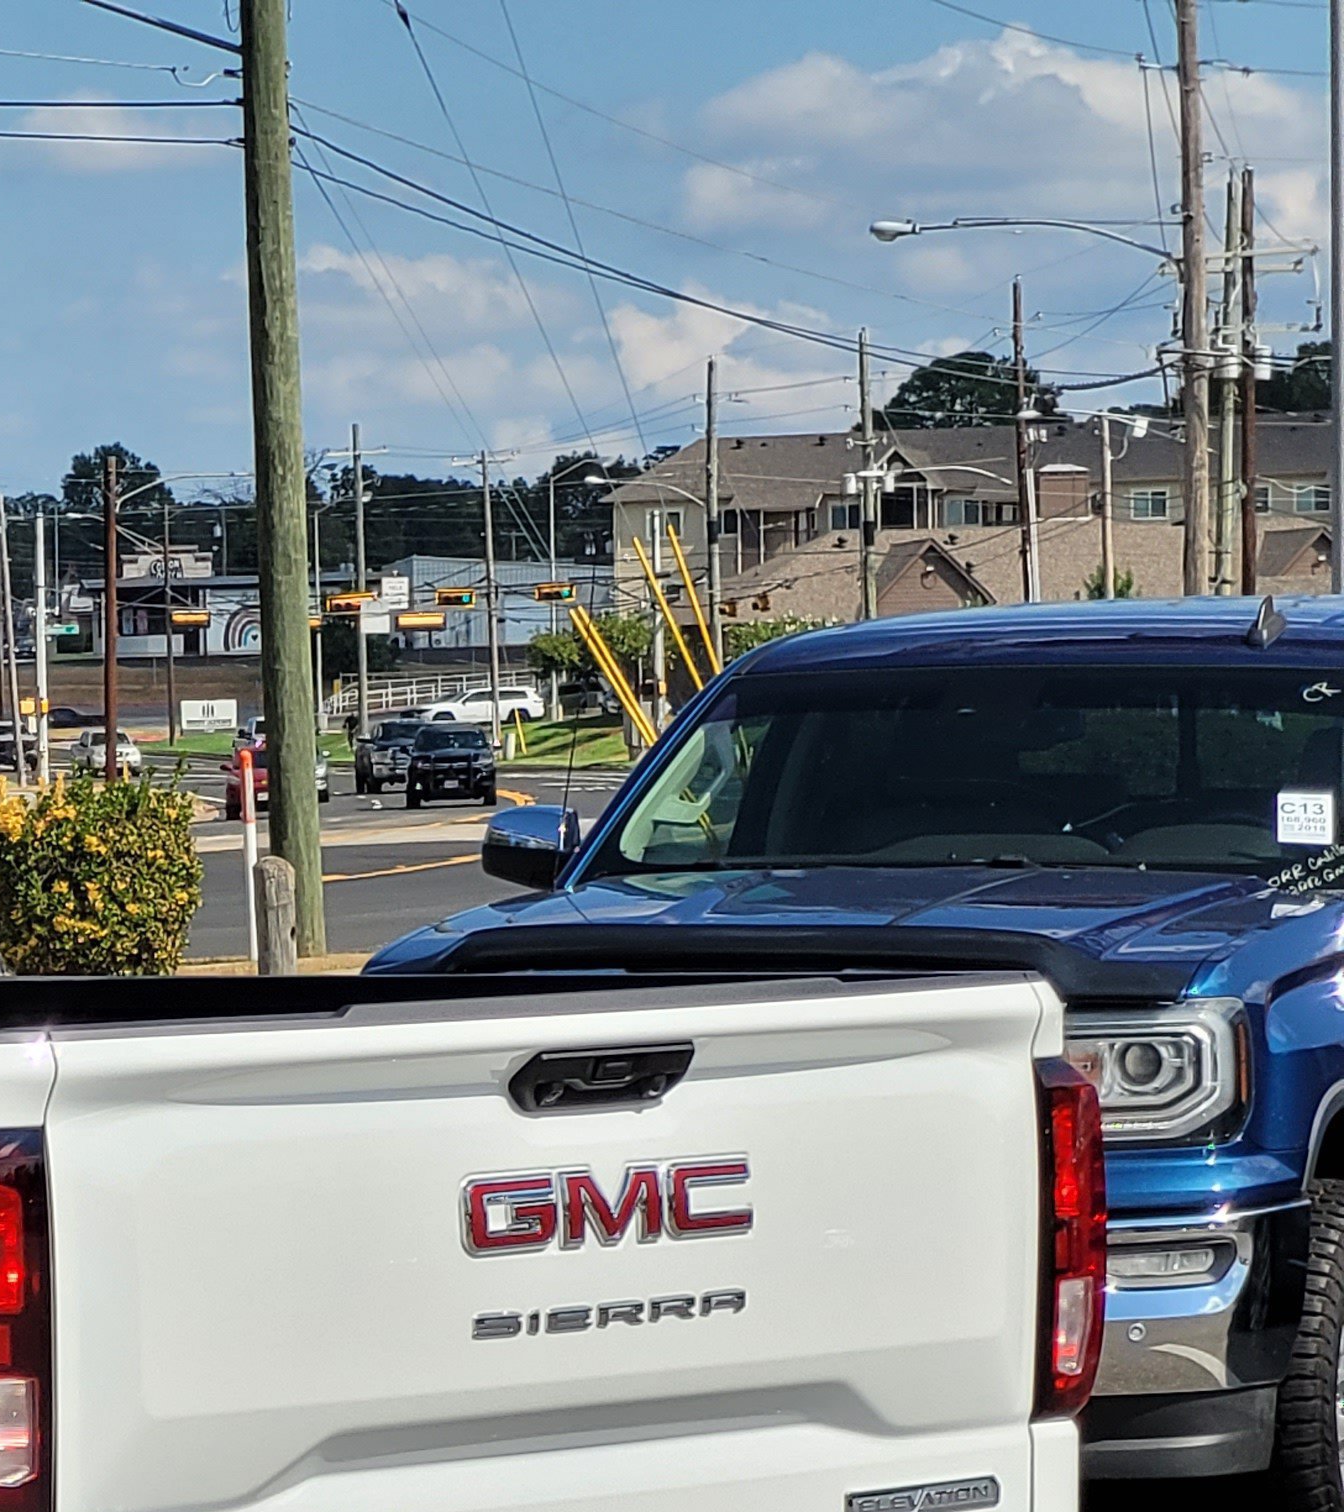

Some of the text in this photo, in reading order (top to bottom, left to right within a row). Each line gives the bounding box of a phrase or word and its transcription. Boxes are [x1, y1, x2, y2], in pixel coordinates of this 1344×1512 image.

[1280, 802, 1325, 815] C13
[1267, 863, 1307, 888] ORR
[461, 1151, 754, 1260] GMC
[471, 1287, 747, 1341] SIERRA
